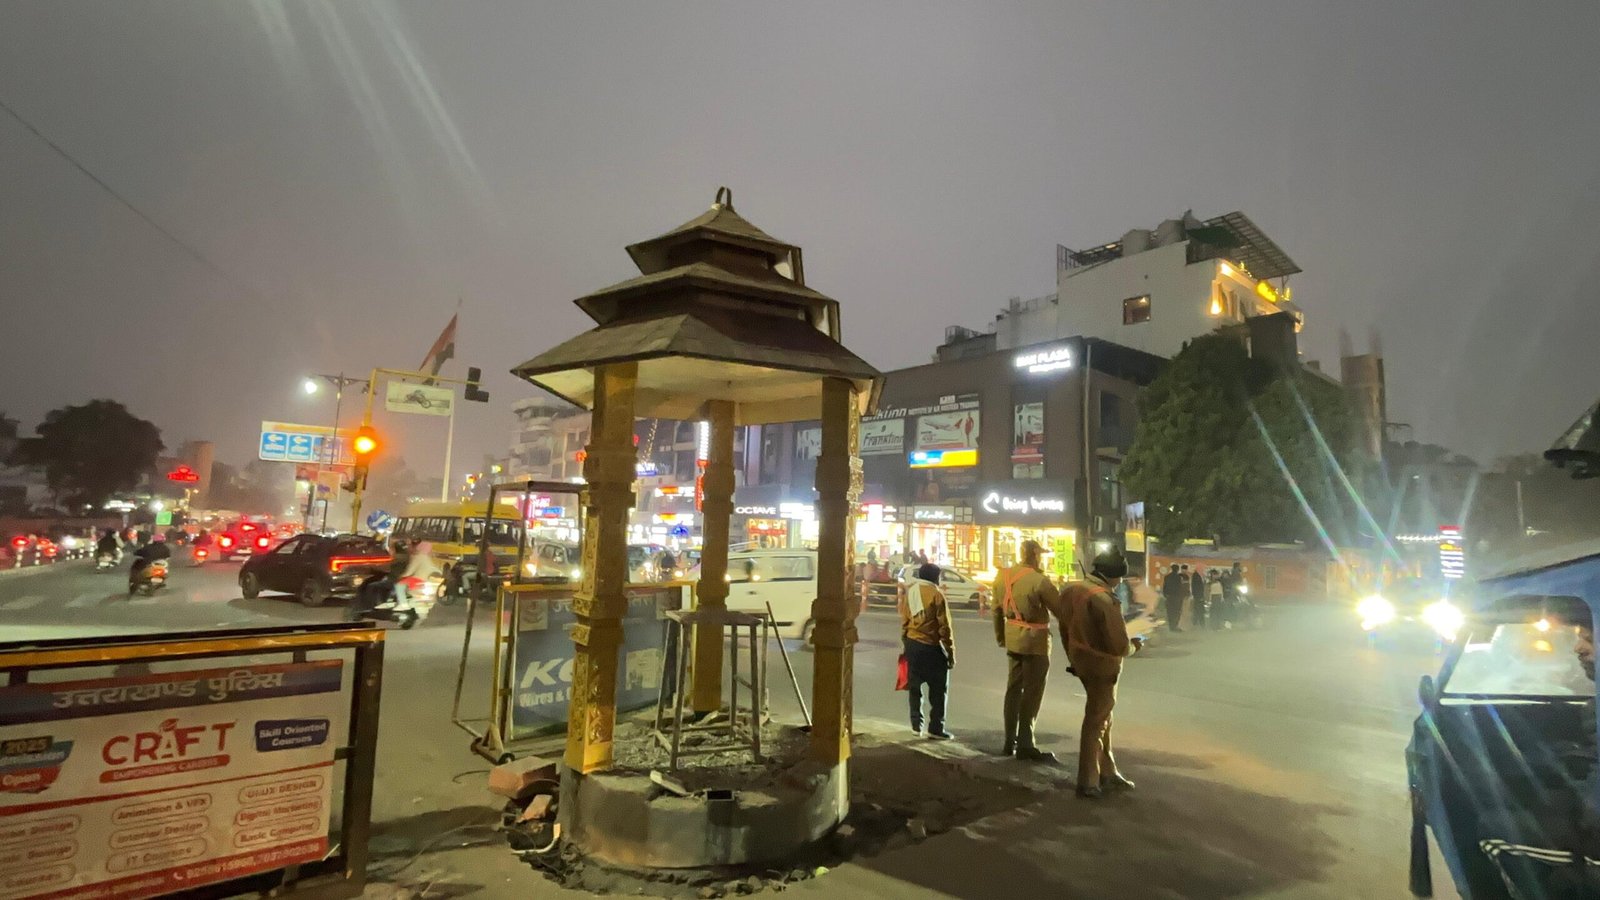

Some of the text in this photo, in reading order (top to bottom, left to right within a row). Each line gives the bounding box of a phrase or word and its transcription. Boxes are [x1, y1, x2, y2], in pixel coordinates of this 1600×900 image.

[735, 506, 777, 515] OCTAVE
[1057, 539, 1065, 570] SALE
[53, 669, 284, 709] उत्तराखण्ड पुलिस
[259, 722, 327, 739] Skill Oriented
[102, 720, 236, 766] CRAFT
[272, 735, 313, 747] Courses
[175, 801, 183, 810] &
